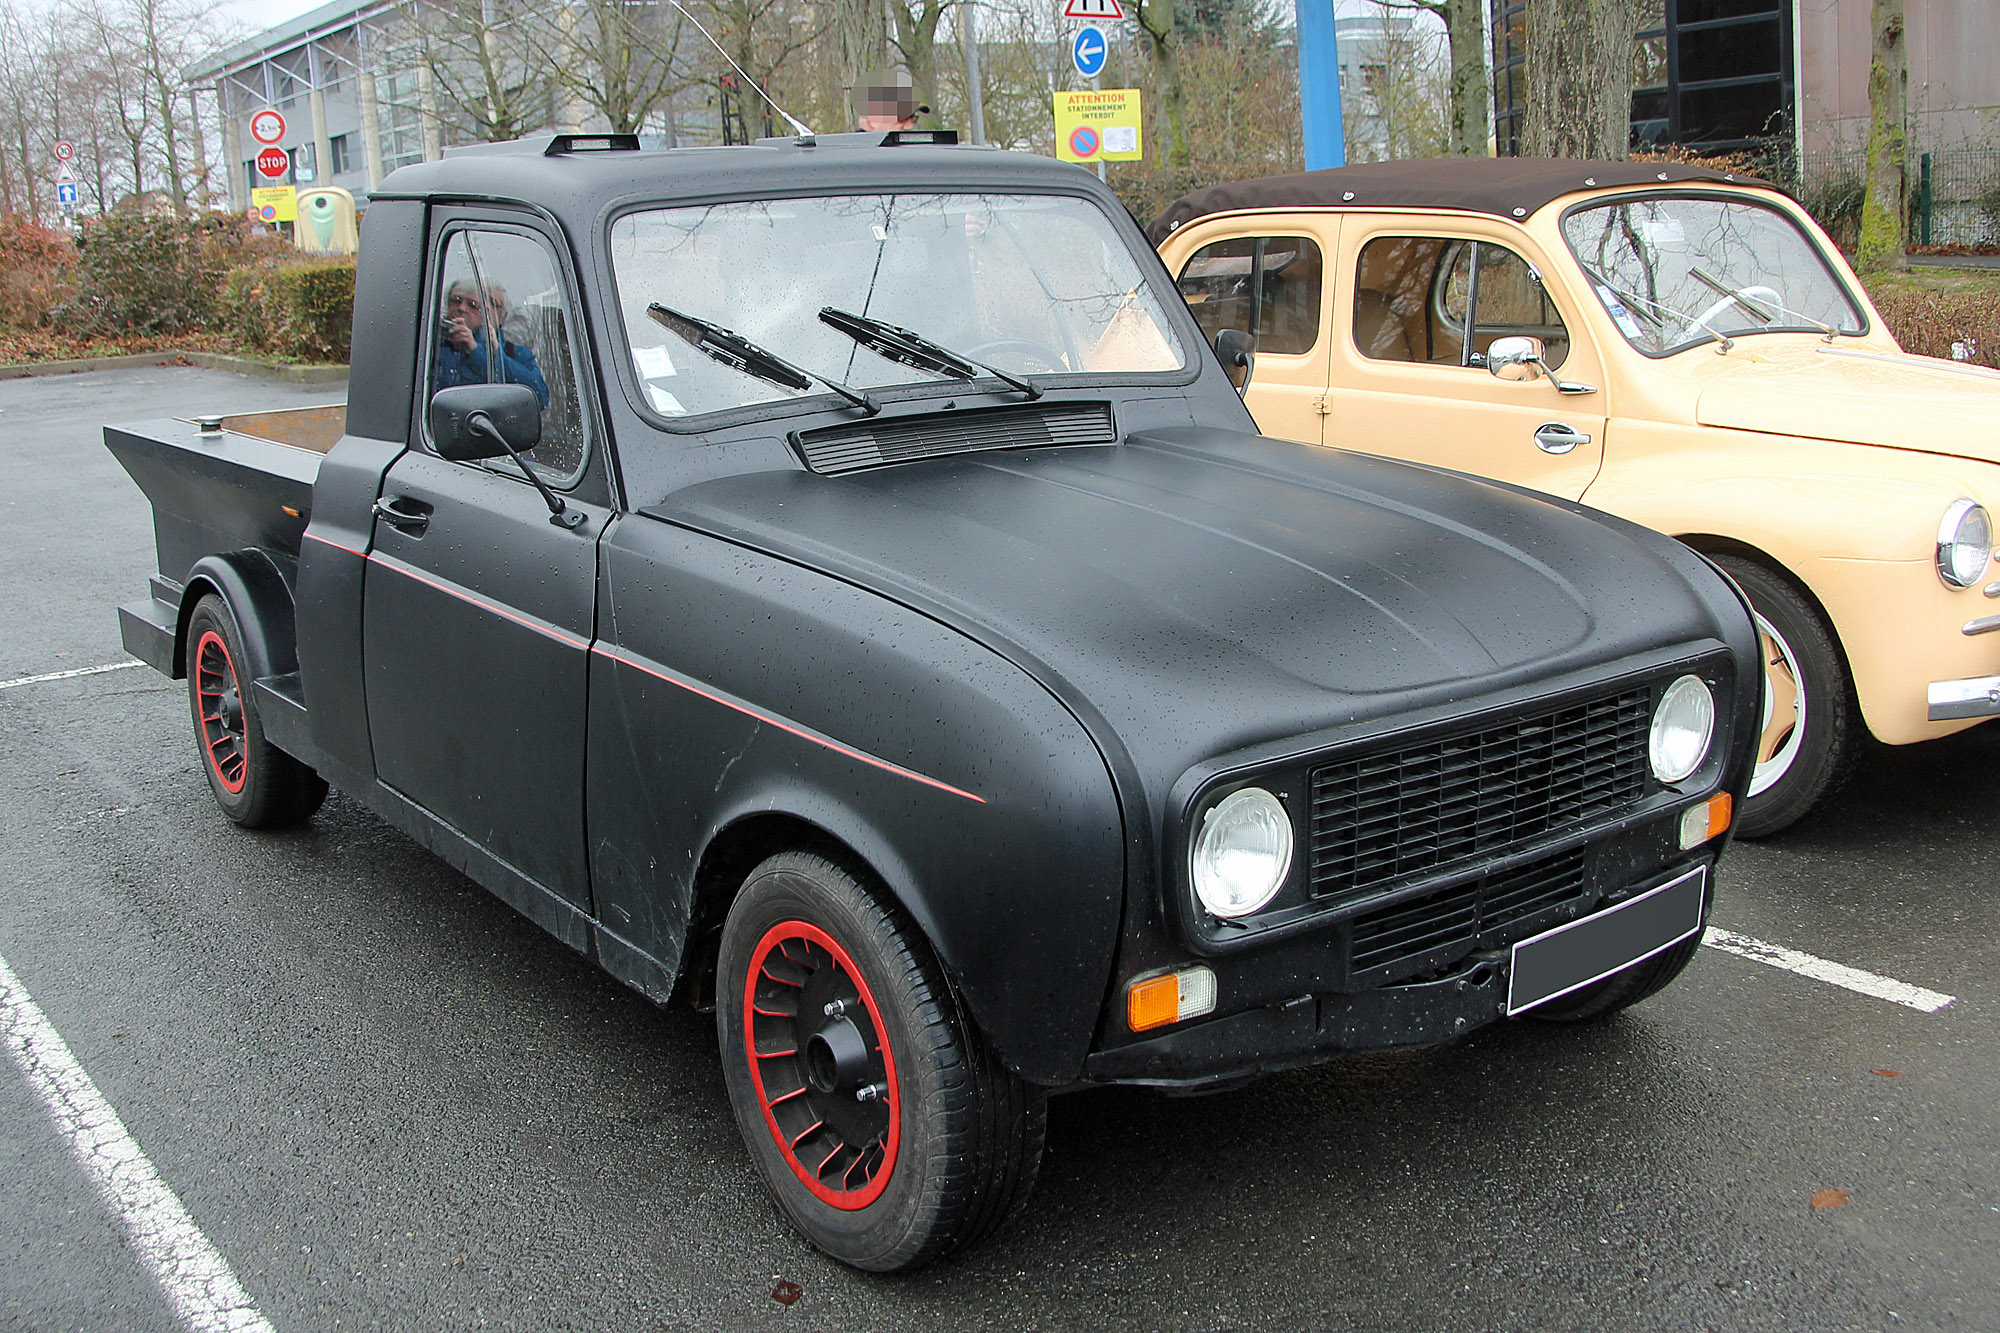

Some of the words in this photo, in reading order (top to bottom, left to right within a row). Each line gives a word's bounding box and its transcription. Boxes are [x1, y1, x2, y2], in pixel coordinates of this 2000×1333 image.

[1068, 94, 1125, 104] ATTENTION
[1067, 104, 1126, 112] STATIONNEMENT
[259, 156, 286, 169] STOP
